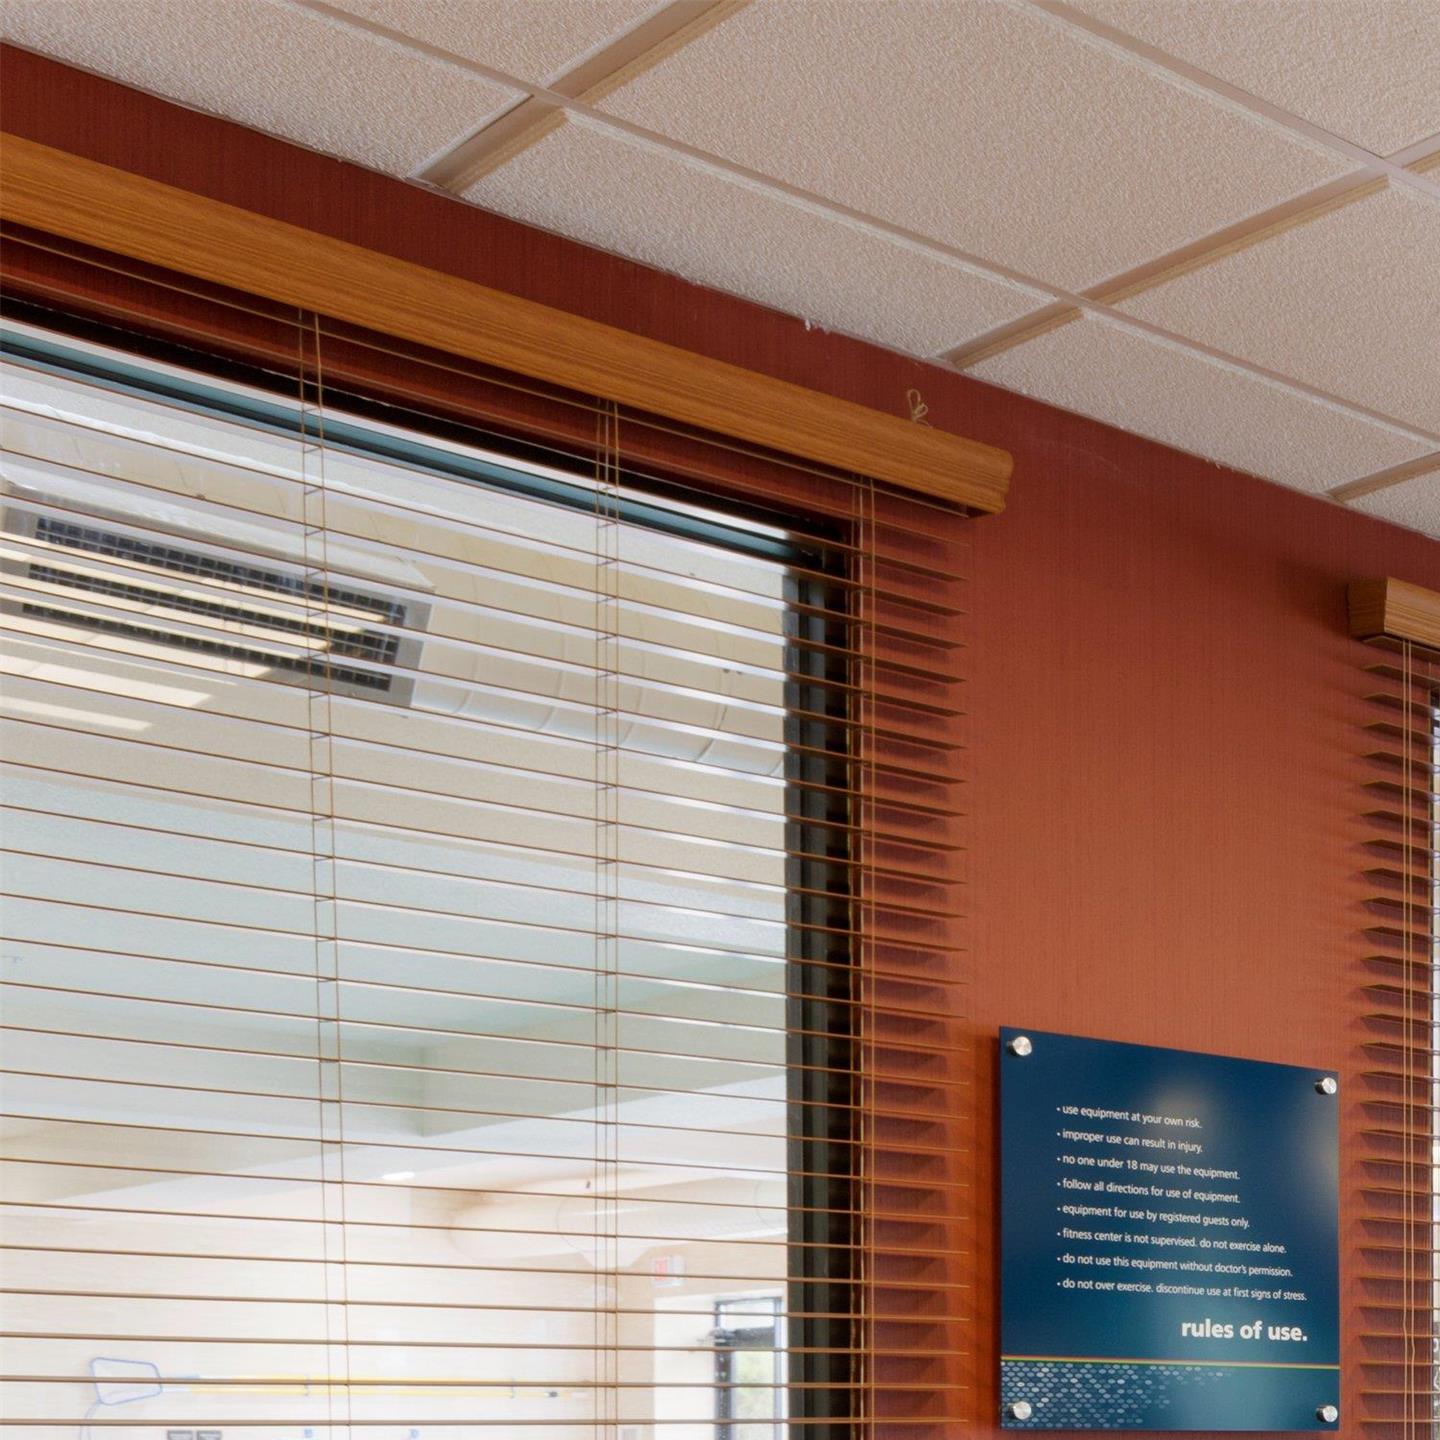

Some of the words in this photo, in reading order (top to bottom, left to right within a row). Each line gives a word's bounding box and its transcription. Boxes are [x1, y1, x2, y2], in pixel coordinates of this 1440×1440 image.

[1063, 1105, 1079, 1115] use
[1081, 1107, 1129, 1121] equipment
[1131, 1113, 1140, 1121] at
[1142, 1115, 1162, 1124] your
[1164, 1117, 1183, 1126] own
[1186, 1117, 1202, 1128] risk.
[1063, 1129, 1103, 1143] improper
[1106, 1135, 1121, 1144] use
[1124, 1137, 1139, 1146] can
[1142, 1138, 1165, 1148] result
[1168, 1140, 1176, 1149] in
[1178, 1142, 1203, 1154] injury.
[1063, 1155, 1075, 1164] no
[1078, 1156, 1095, 1166] one
[1097, 1156, 1123, 1168] under
[1127, 1160, 1138, 1169] 18
[1140, 1162, 1158, 1174] may
[1161, 1164, 1175, 1173] use
[1178, 1165, 1191, 1175] the
[1194, 1167, 1240, 1179] equipment.
[1063, 1178, 1091, 1190] follow
[1094, 1181, 1104, 1191] all
[1106, 1182, 1148, 1195] directions
[1151, 1186, 1164, 1196] for
[1166, 1189, 1180, 1198] use
[1183, 1188, 1191, 1198] of
[1194, 1190, 1240, 1203] equipment.
[1063, 1204, 1111, 1216] equipment
[1114, 1207, 1127, 1218] for
[1129, 1211, 1144, 1219] use
[1147, 1211, 1157, 1222] by
[1159, 1213, 1200, 1226] registered
[1203, 1216, 1229, 1226] guests
[1231, 1217, 1249, 1229] only.
[1063, 1228, 1092, 1240] fitness
[1094, 1231, 1122, 1242] center
[1125, 1232, 1131, 1242] is
[1134, 1234, 1149, 1243] not
[1151, 1236, 1197, 1247] supervised.
[1200, 1239, 1211, 1247] do
[1230, 1242, 1260, 1252] exercise
[1263, 1243, 1287, 1253] alone.
[1063, 1253, 1075, 1264] do
[1078, 1255, 1093, 1265] not
[1096, 1257, 1110, 1266] use
[1114, 1257, 1129, 1267] this
[1131, 1259, 1177, 1270] equipment
[1180, 1262, 1212, 1272] without
[1249, 1266, 1293, 1277] permission.
[1063, 1279, 1075, 1289] do
[1078, 1280, 1094, 1290] not
[1095, 1282, 1114, 1290] over
[1117, 1282, 1153, 1293] exercise.
[1156, 1283, 1204, 1295] discontinue
[1207, 1288, 1221, 1296] use
[1223, 1288, 1231, 1297] at
[1233, 1288, 1249, 1298] first
[1251, 1288, 1271, 1300] signs
[1273, 1290, 1281, 1299] of
[1284, 1291, 1307, 1301] stress.
[1182, 1318, 1234, 1338] rules
[1240, 1320, 1263, 1339] of
[1268, 1326, 1307, 1341] use.
